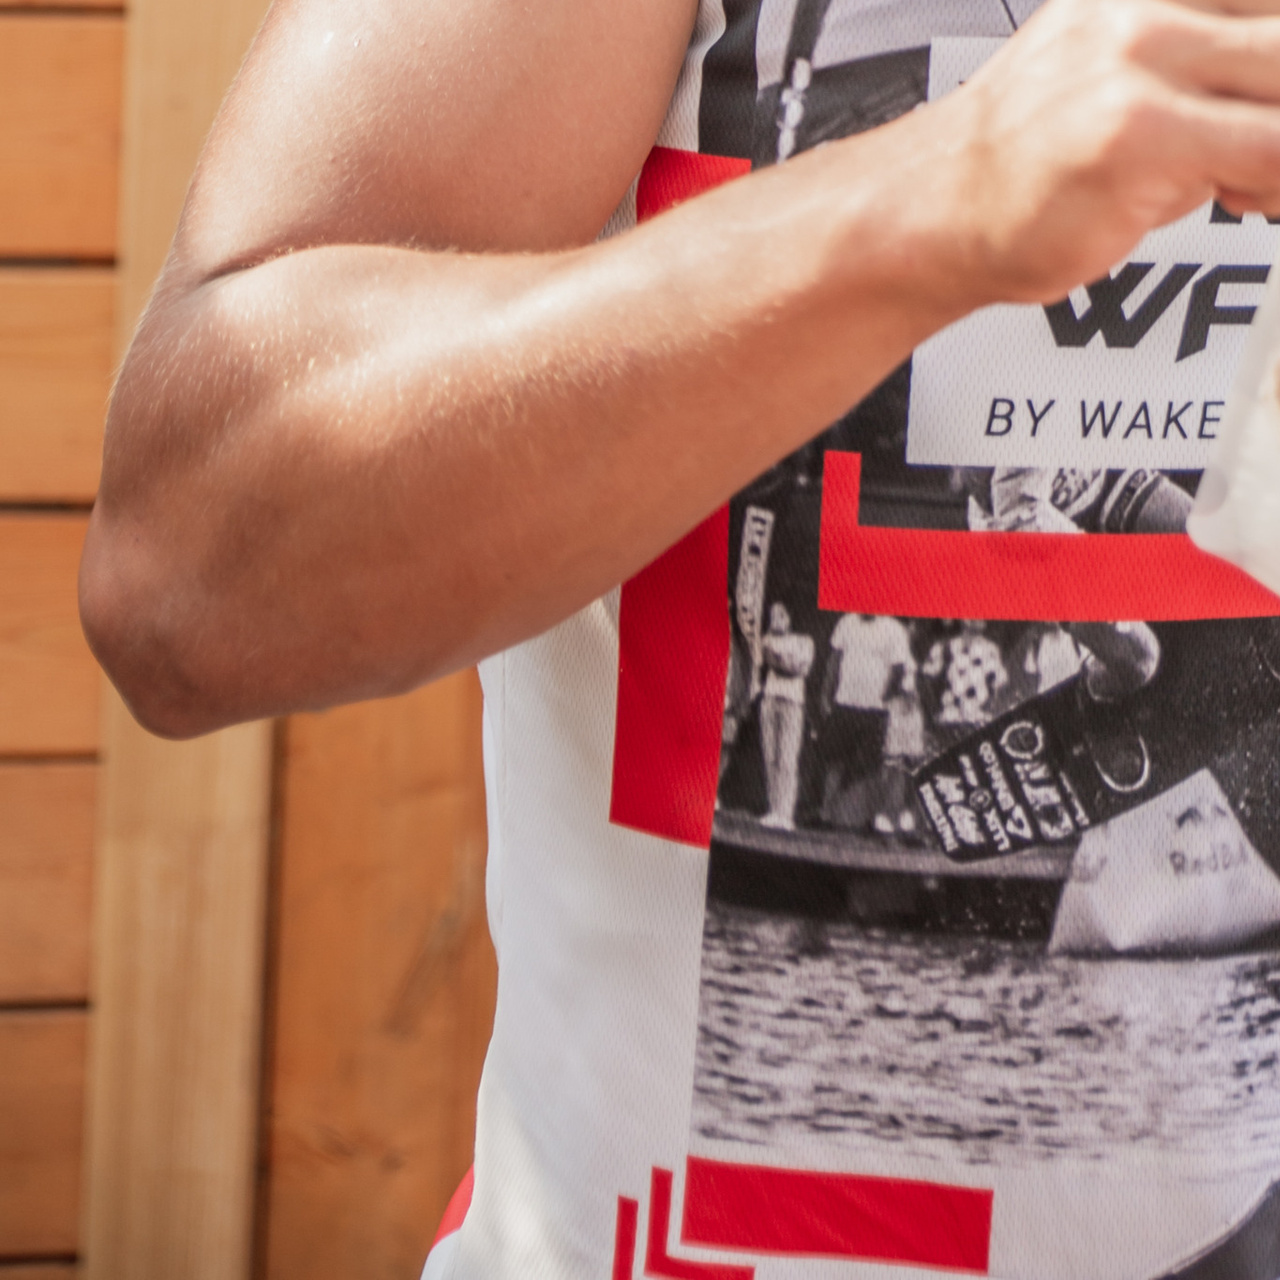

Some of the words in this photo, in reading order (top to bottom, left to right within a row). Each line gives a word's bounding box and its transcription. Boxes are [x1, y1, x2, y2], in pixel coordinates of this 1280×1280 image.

[1042, 262, 1271, 363] WF
[985, 398, 1055, 437] BY
[1080, 400, 1225, 439] WAKE
